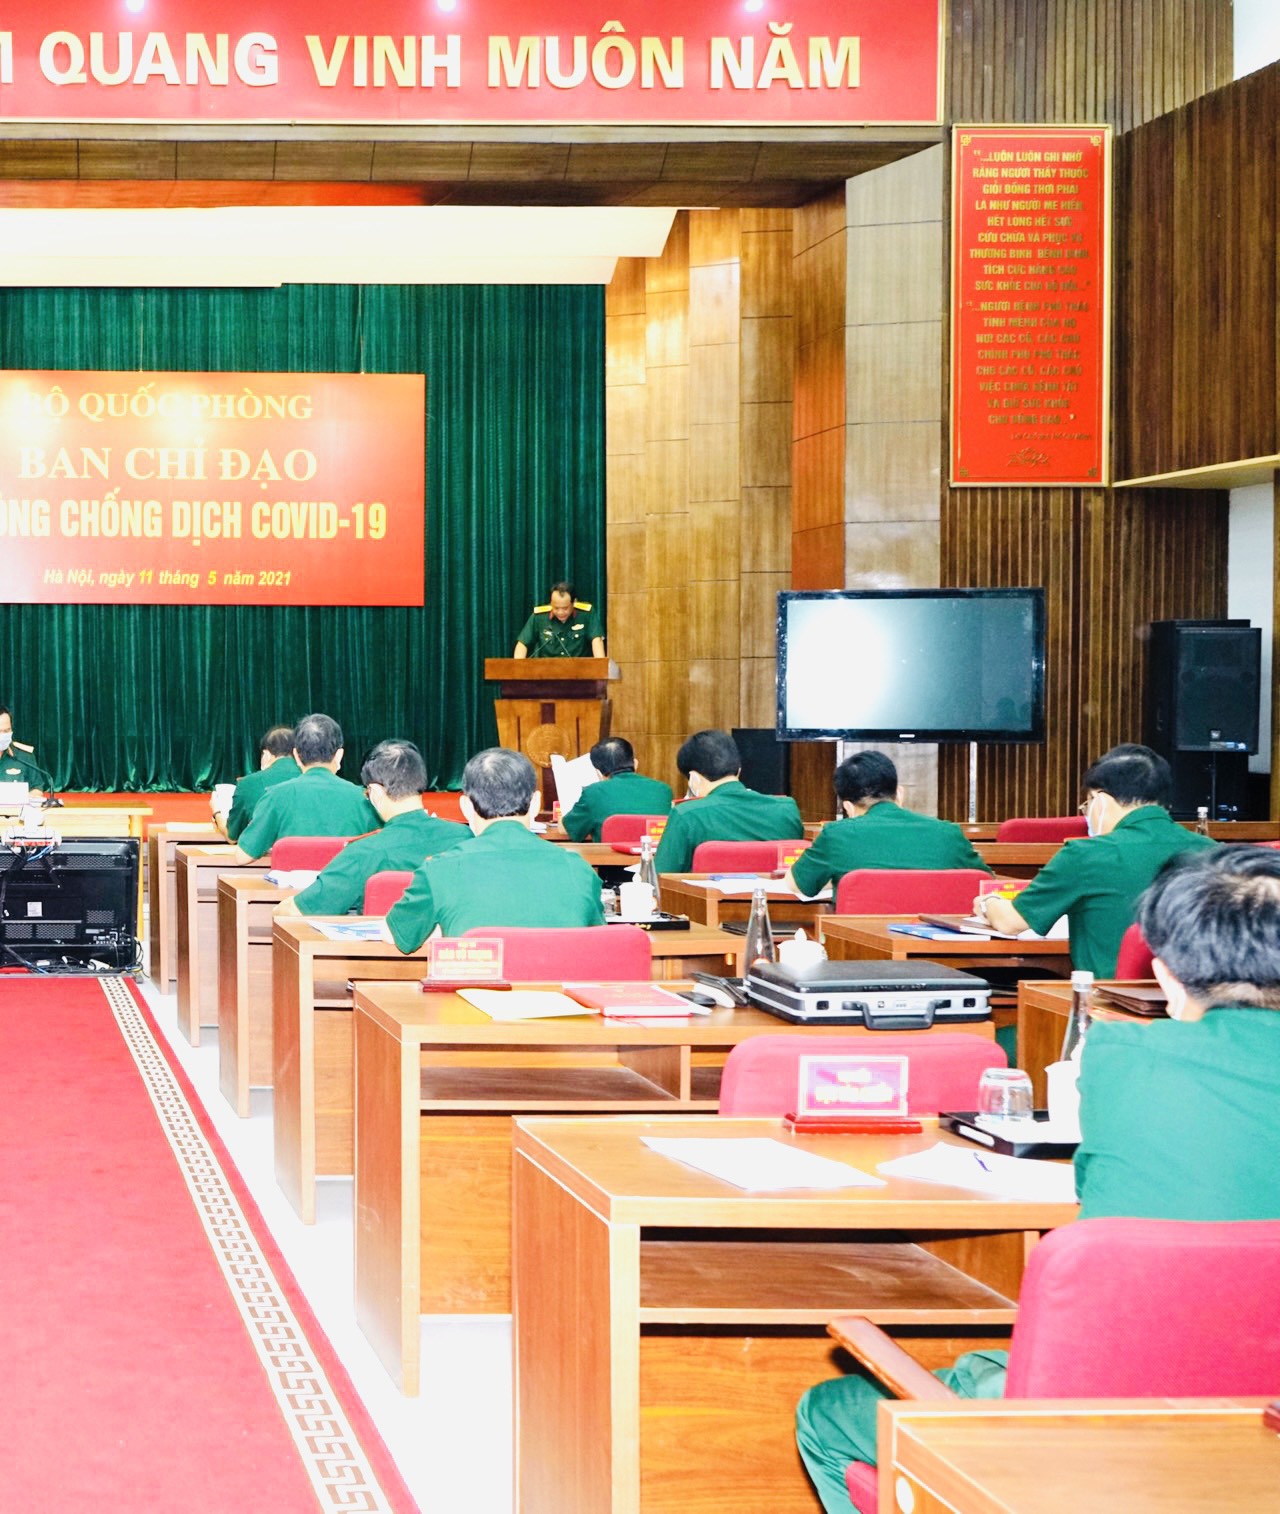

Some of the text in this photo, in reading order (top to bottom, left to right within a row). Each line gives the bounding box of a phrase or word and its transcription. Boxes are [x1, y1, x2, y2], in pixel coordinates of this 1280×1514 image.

[38, 31, 278, 87] QUANG
[305, 35, 461, 88] VINH
[487, 21, 685, 89] MUÔN
[709, 22, 861, 90] NĂM
[188, 388, 314, 421] PHÒNG
[19, 437, 318, 490] BAN CHỈ ĐẠO
[60, 487, 163, 539] CHỐNG
[172, 501, 242, 546] DỊCH
[251, 502, 388, 541] COVID-19
[43, 569, 292, 590] Hà Nội, ngày 11 tháng 5 năm 2021
